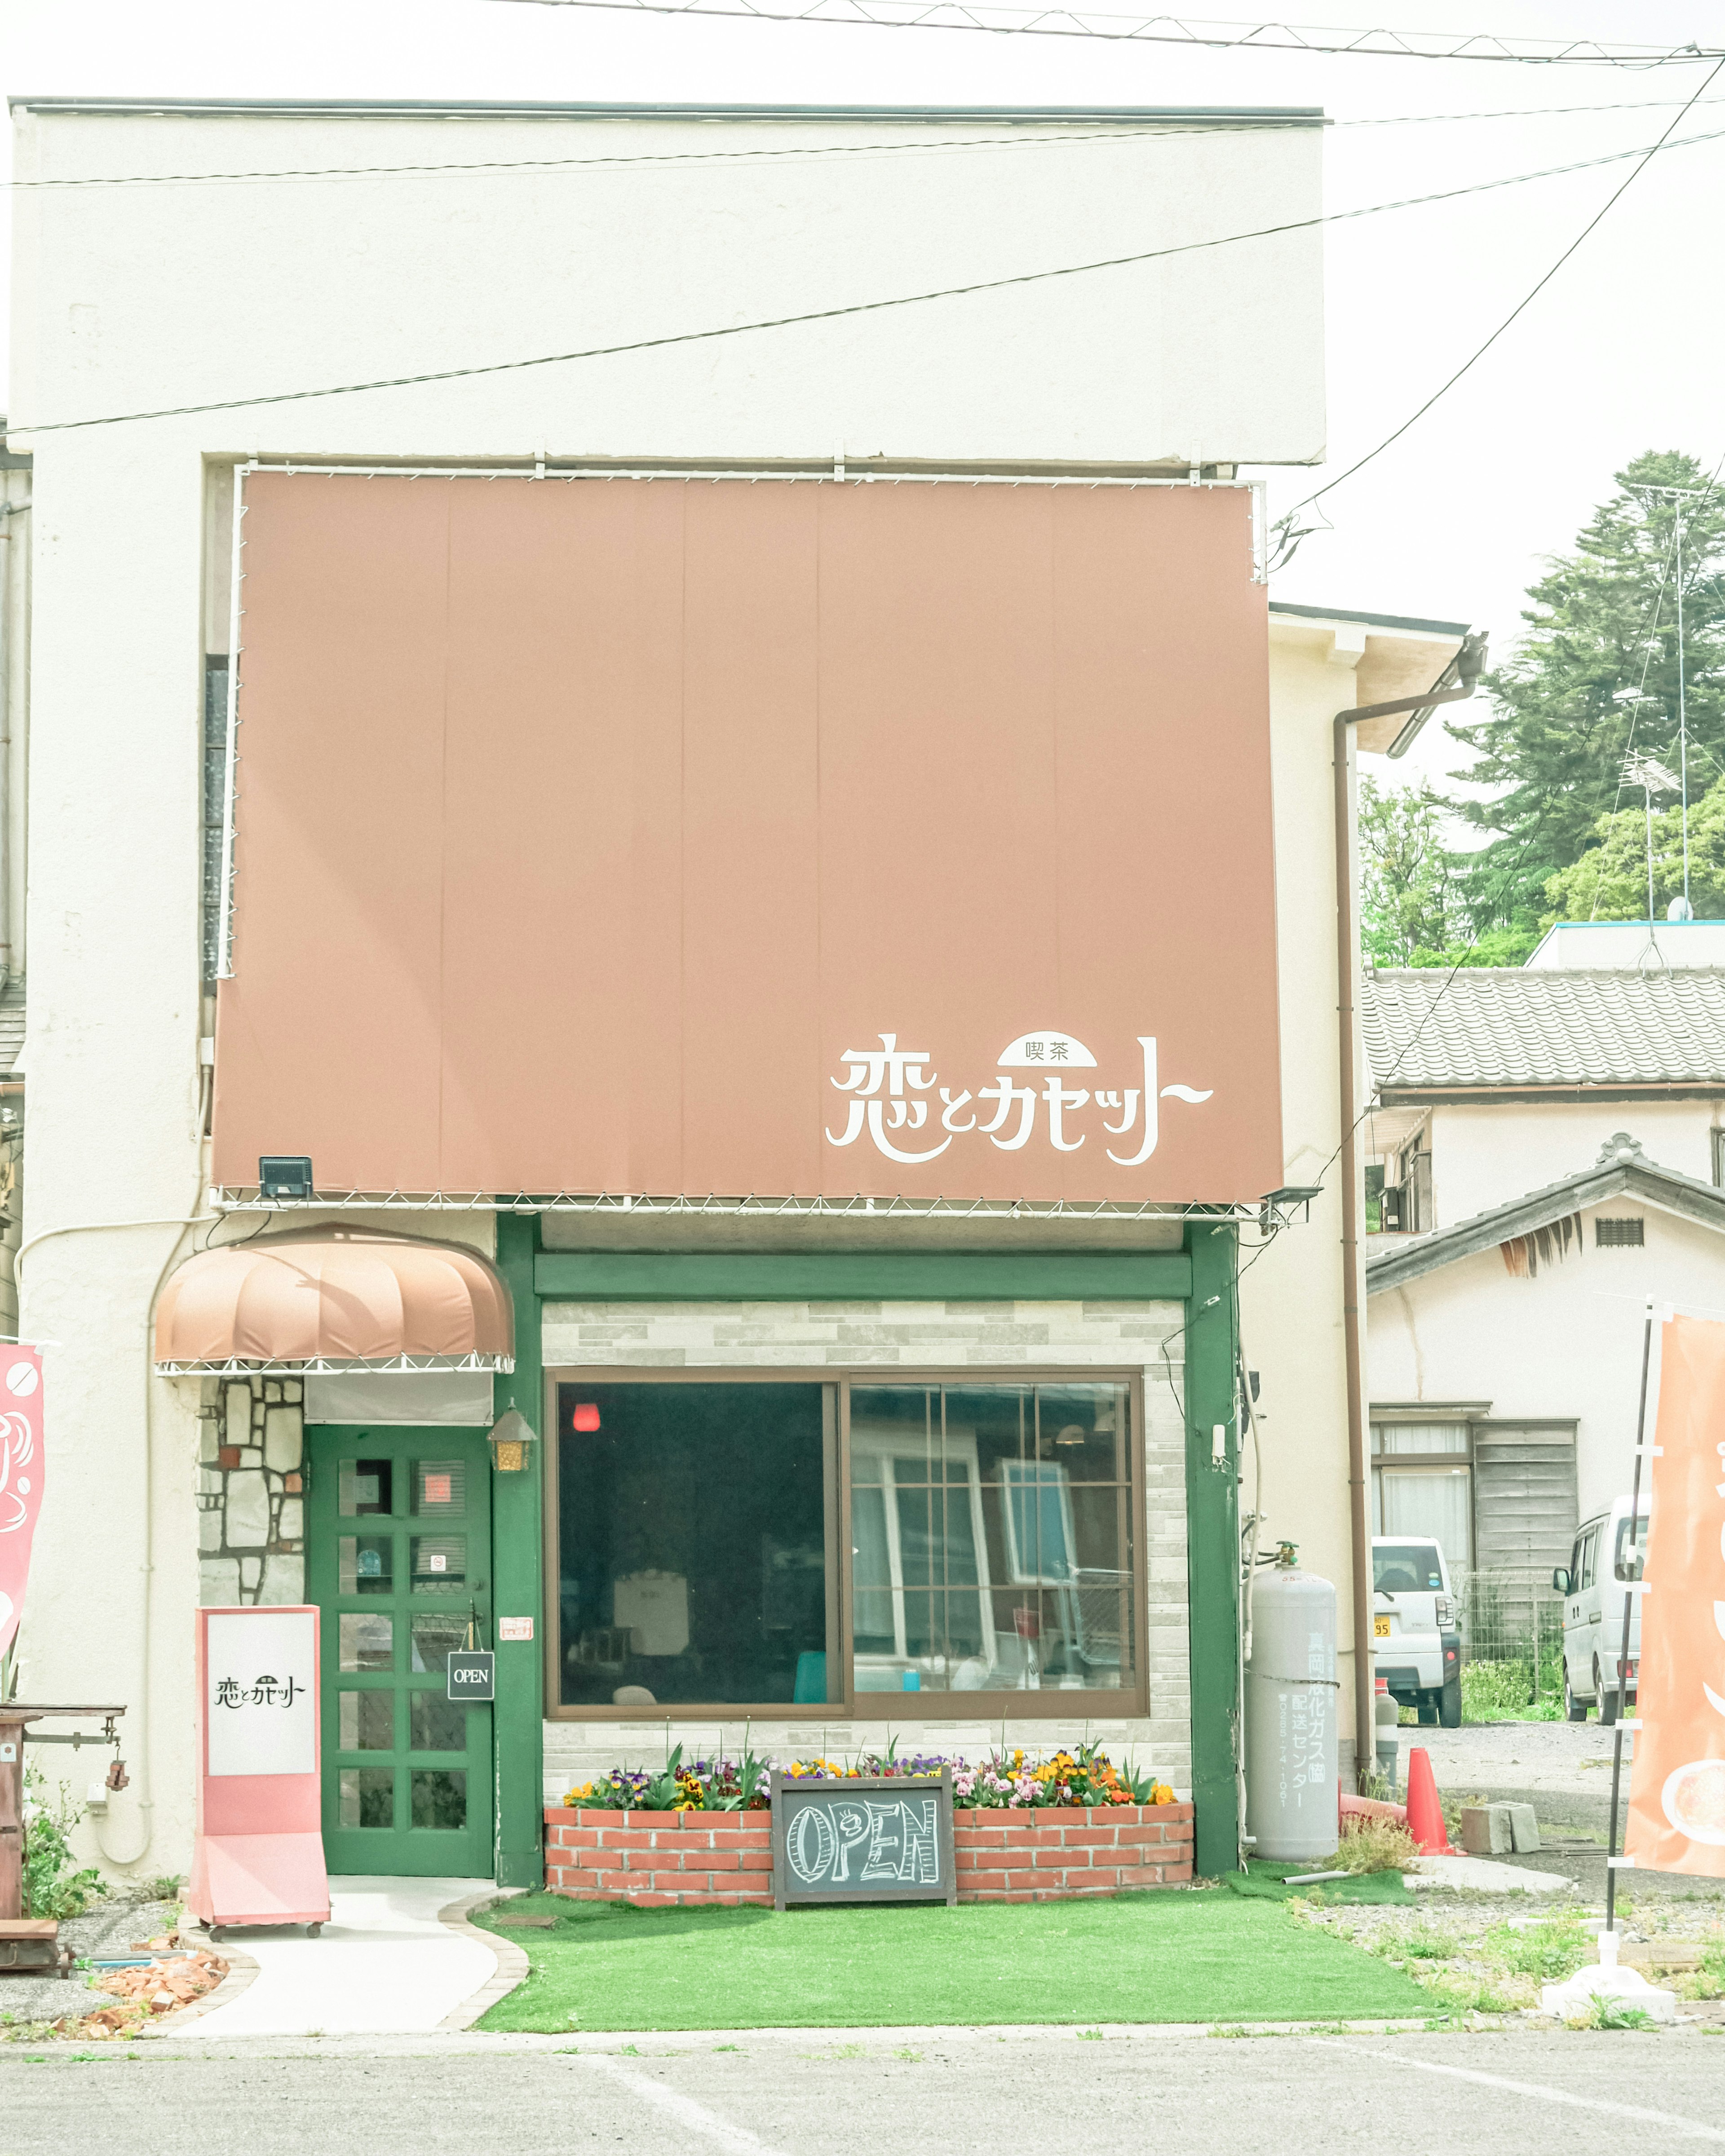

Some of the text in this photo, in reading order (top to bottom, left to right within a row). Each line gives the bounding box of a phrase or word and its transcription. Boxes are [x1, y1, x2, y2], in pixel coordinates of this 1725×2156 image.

[1025, 1041, 1069, 1061] 喫茶
[825, 1033, 1214, 1166] 恋とカセット
[214, 1676, 306, 1709] 恋とカセット
[453, 1669, 489, 1683] OPEN
[1292, 1694, 1308, 1808] 配送センター
[787, 1799, 939, 1883] OPEN
